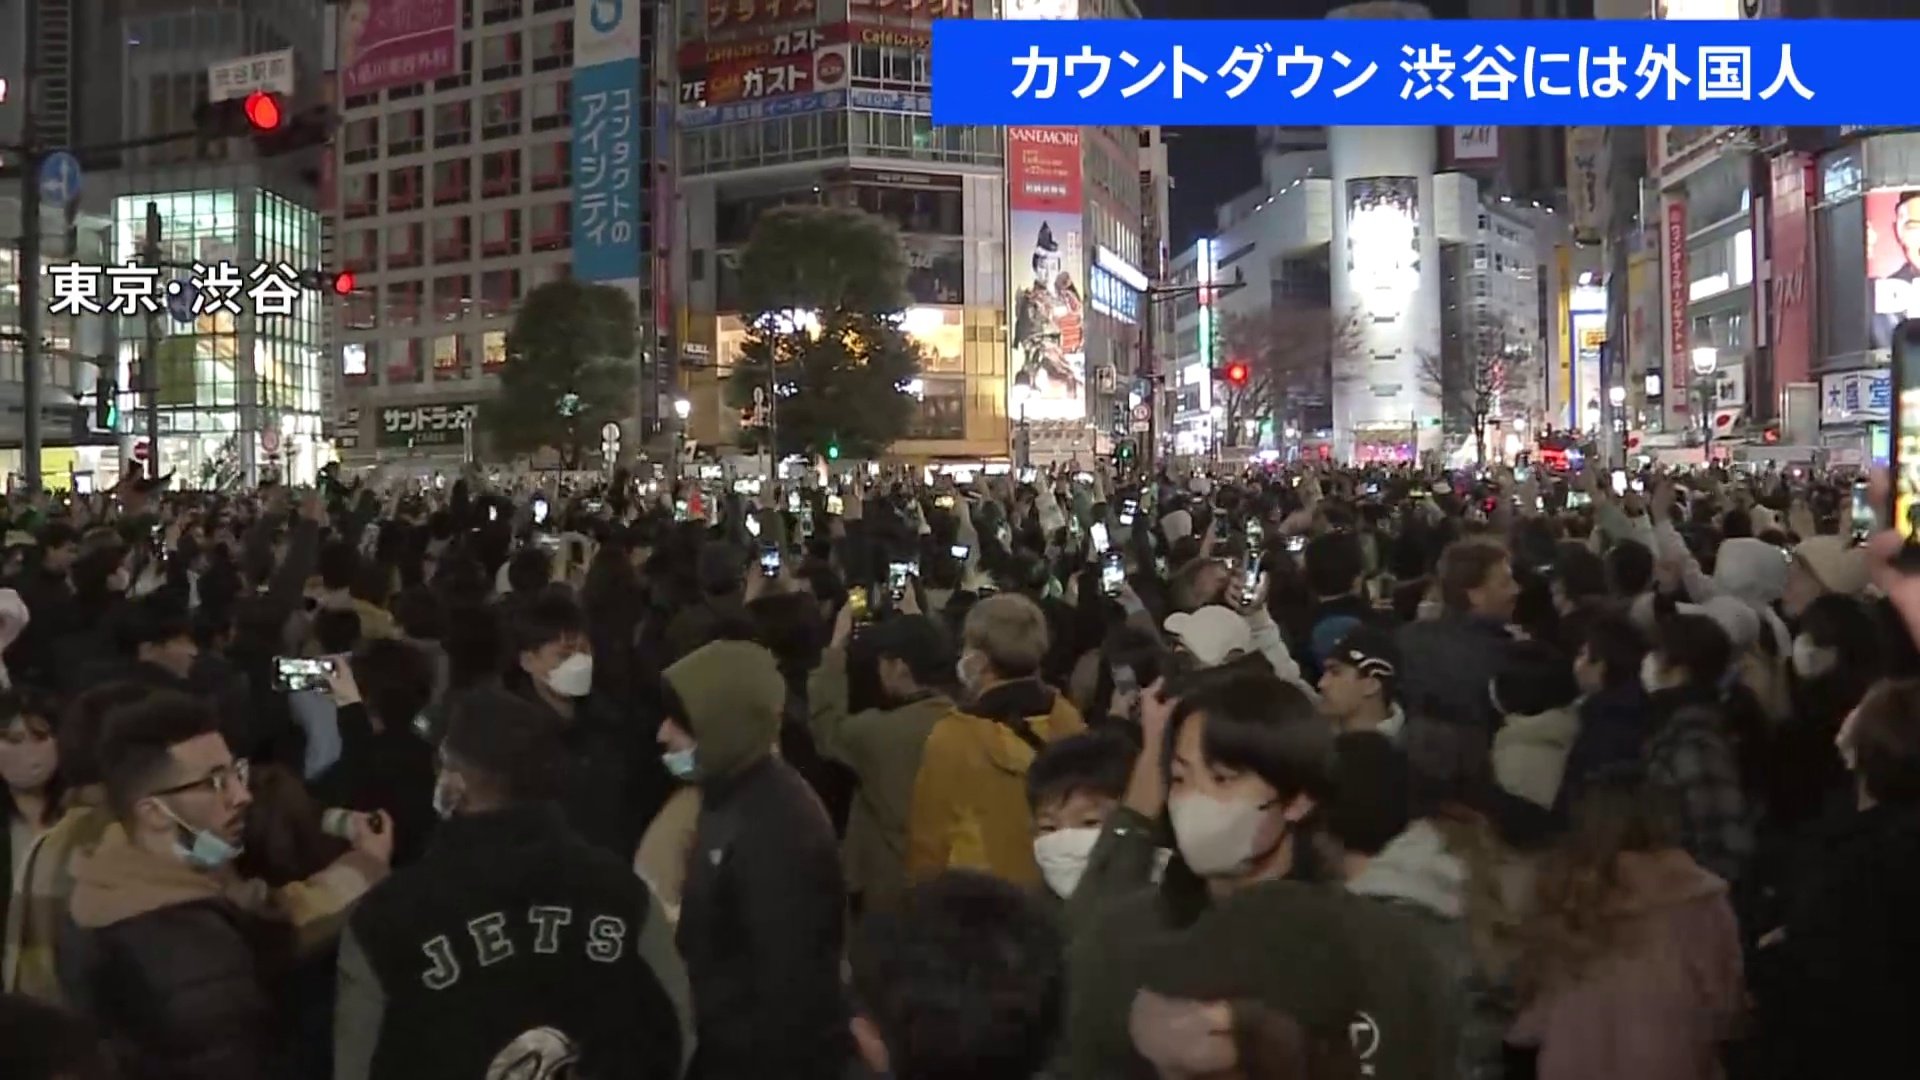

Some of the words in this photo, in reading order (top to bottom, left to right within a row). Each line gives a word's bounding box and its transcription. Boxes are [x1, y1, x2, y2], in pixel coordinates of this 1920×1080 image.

[773, 29, 825, 55] ガスト
[742, 65, 808, 98] ガスト
[611, 88, 632, 244] コンタクトの
[1009, 128, 1079, 147] SANEMORI
[580, 91, 608, 246] アイシティ
[422, 905, 626, 990] JETS
